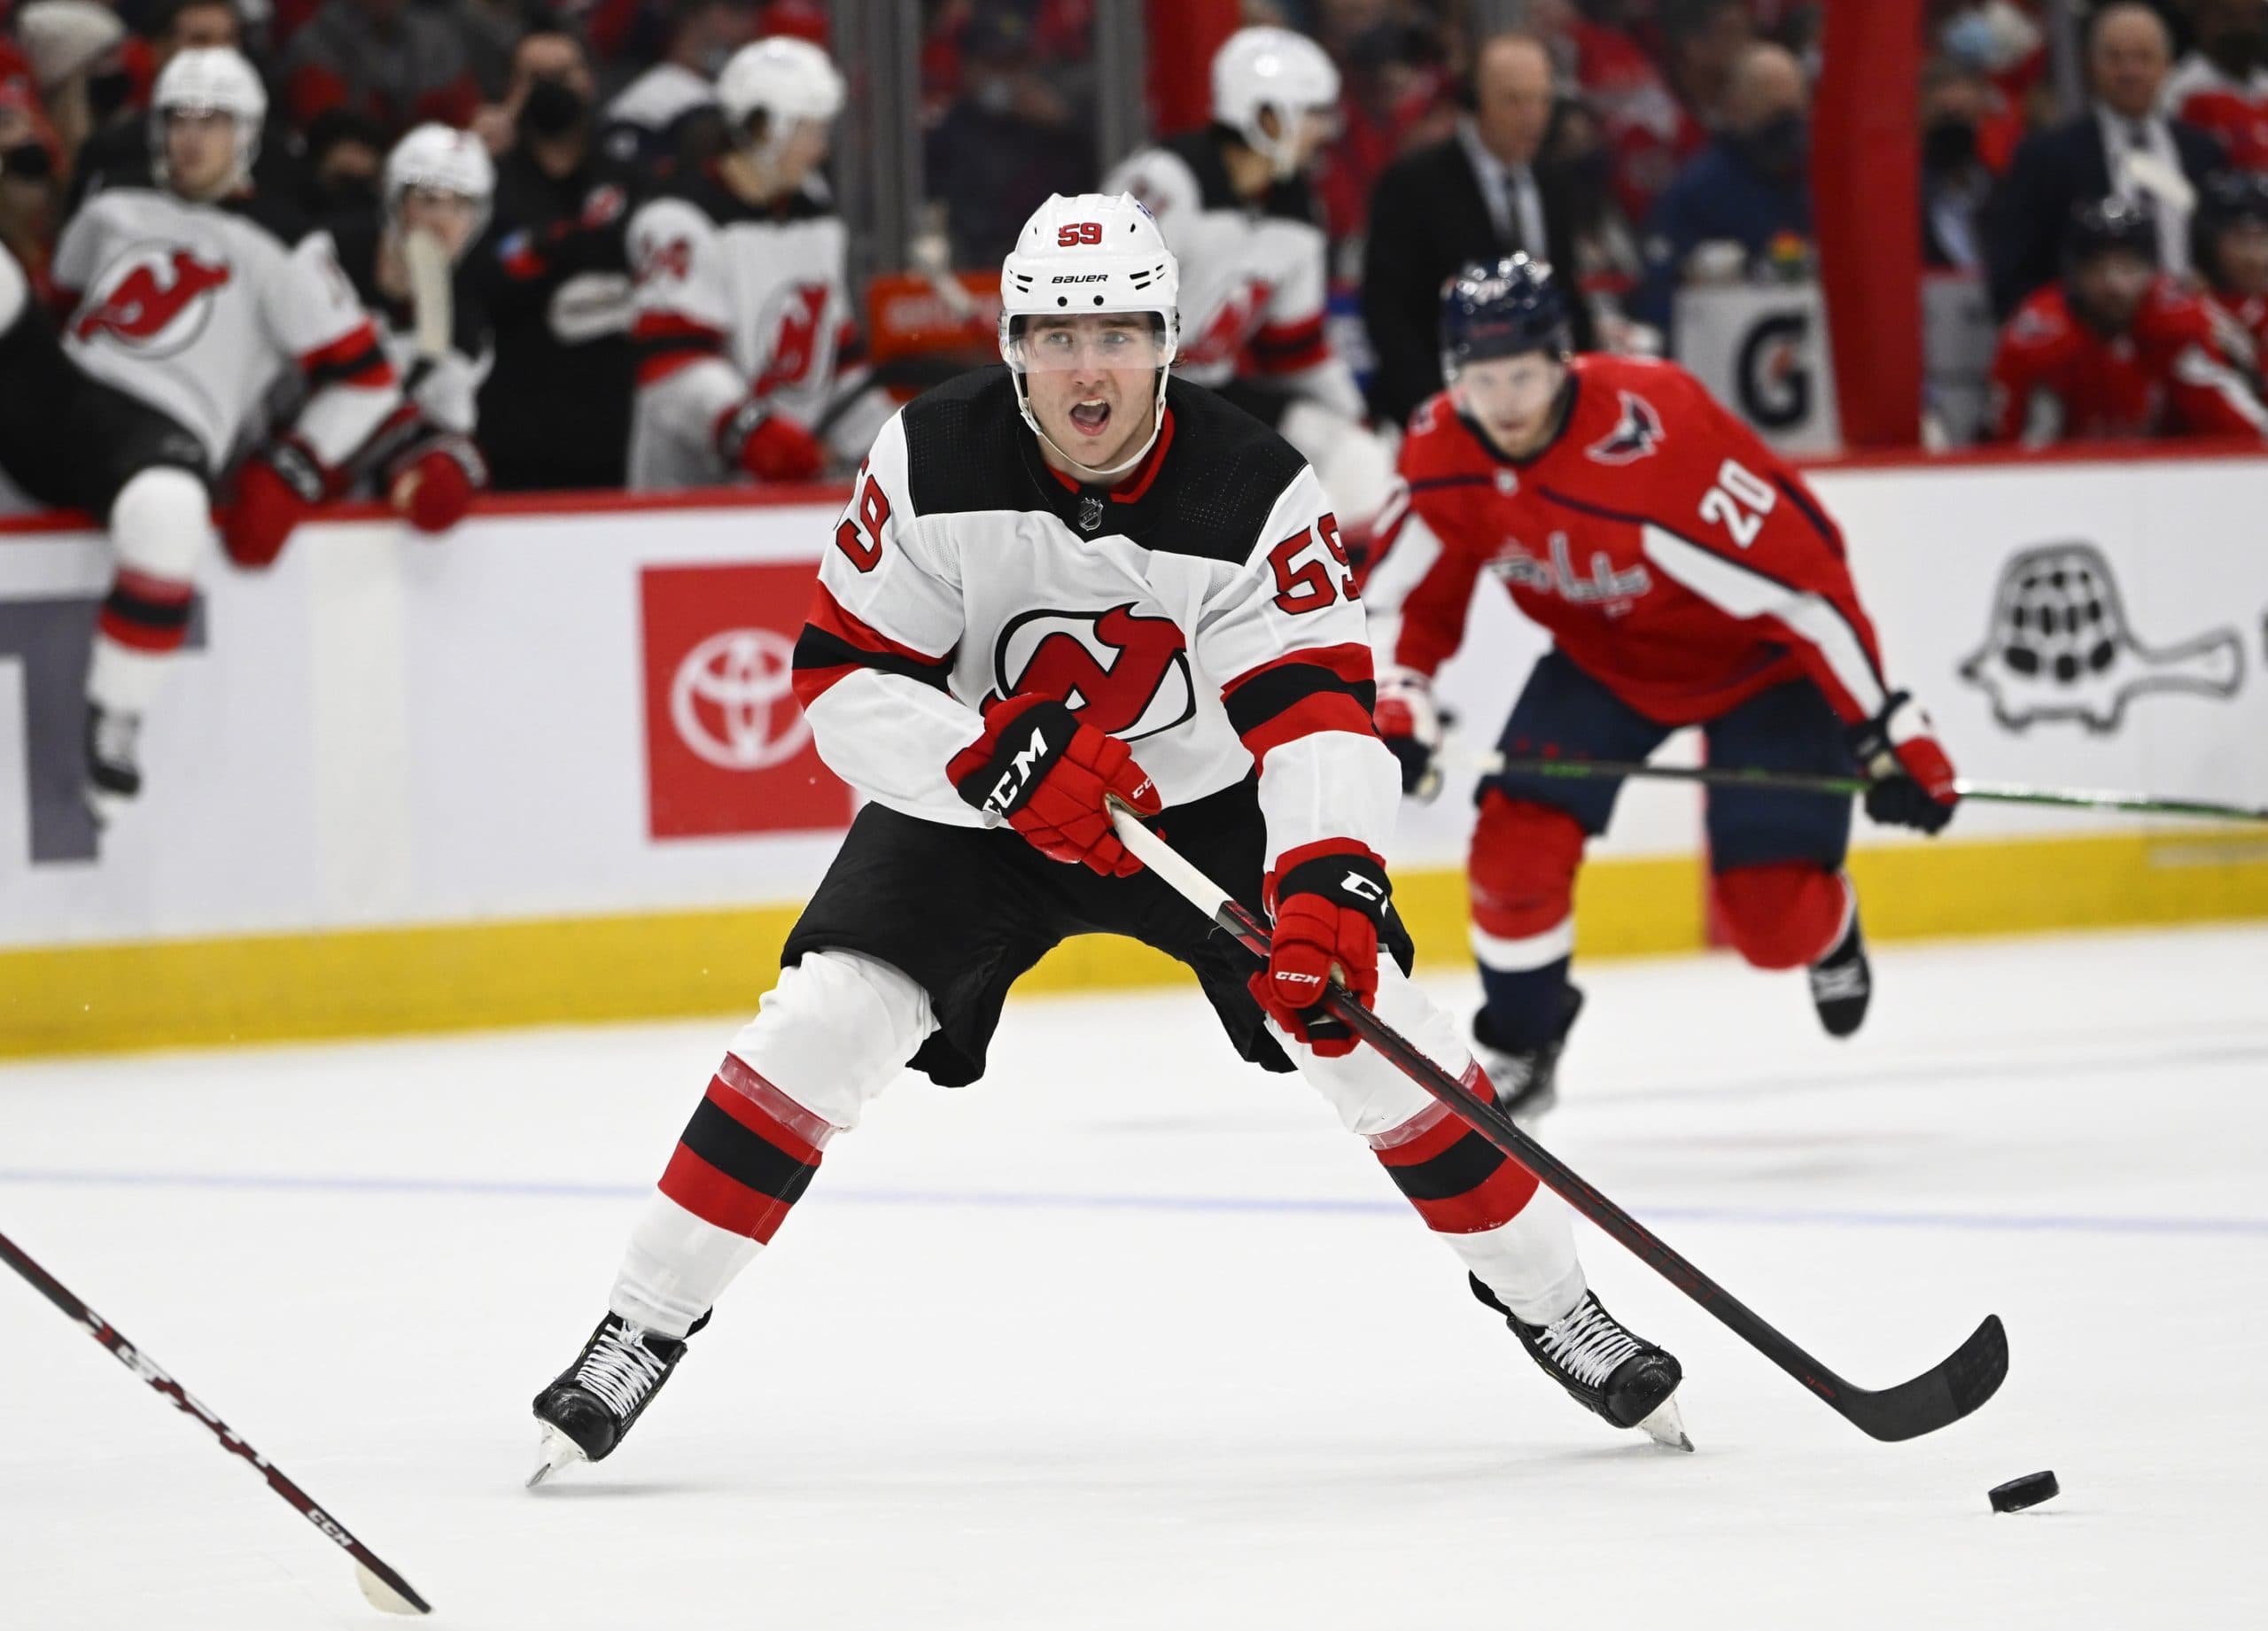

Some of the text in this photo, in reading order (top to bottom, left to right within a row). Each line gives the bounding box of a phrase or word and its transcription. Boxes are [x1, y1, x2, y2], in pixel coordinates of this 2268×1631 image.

[1057, 222, 1103, 248] 59
[1051, 274, 1108, 284] BAUER
[835, 455, 891, 574] 9
[1698, 457, 1777, 548] 20
[1275, 970, 1321, 986] CCM
[307, 1508, 353, 1547] CCM
